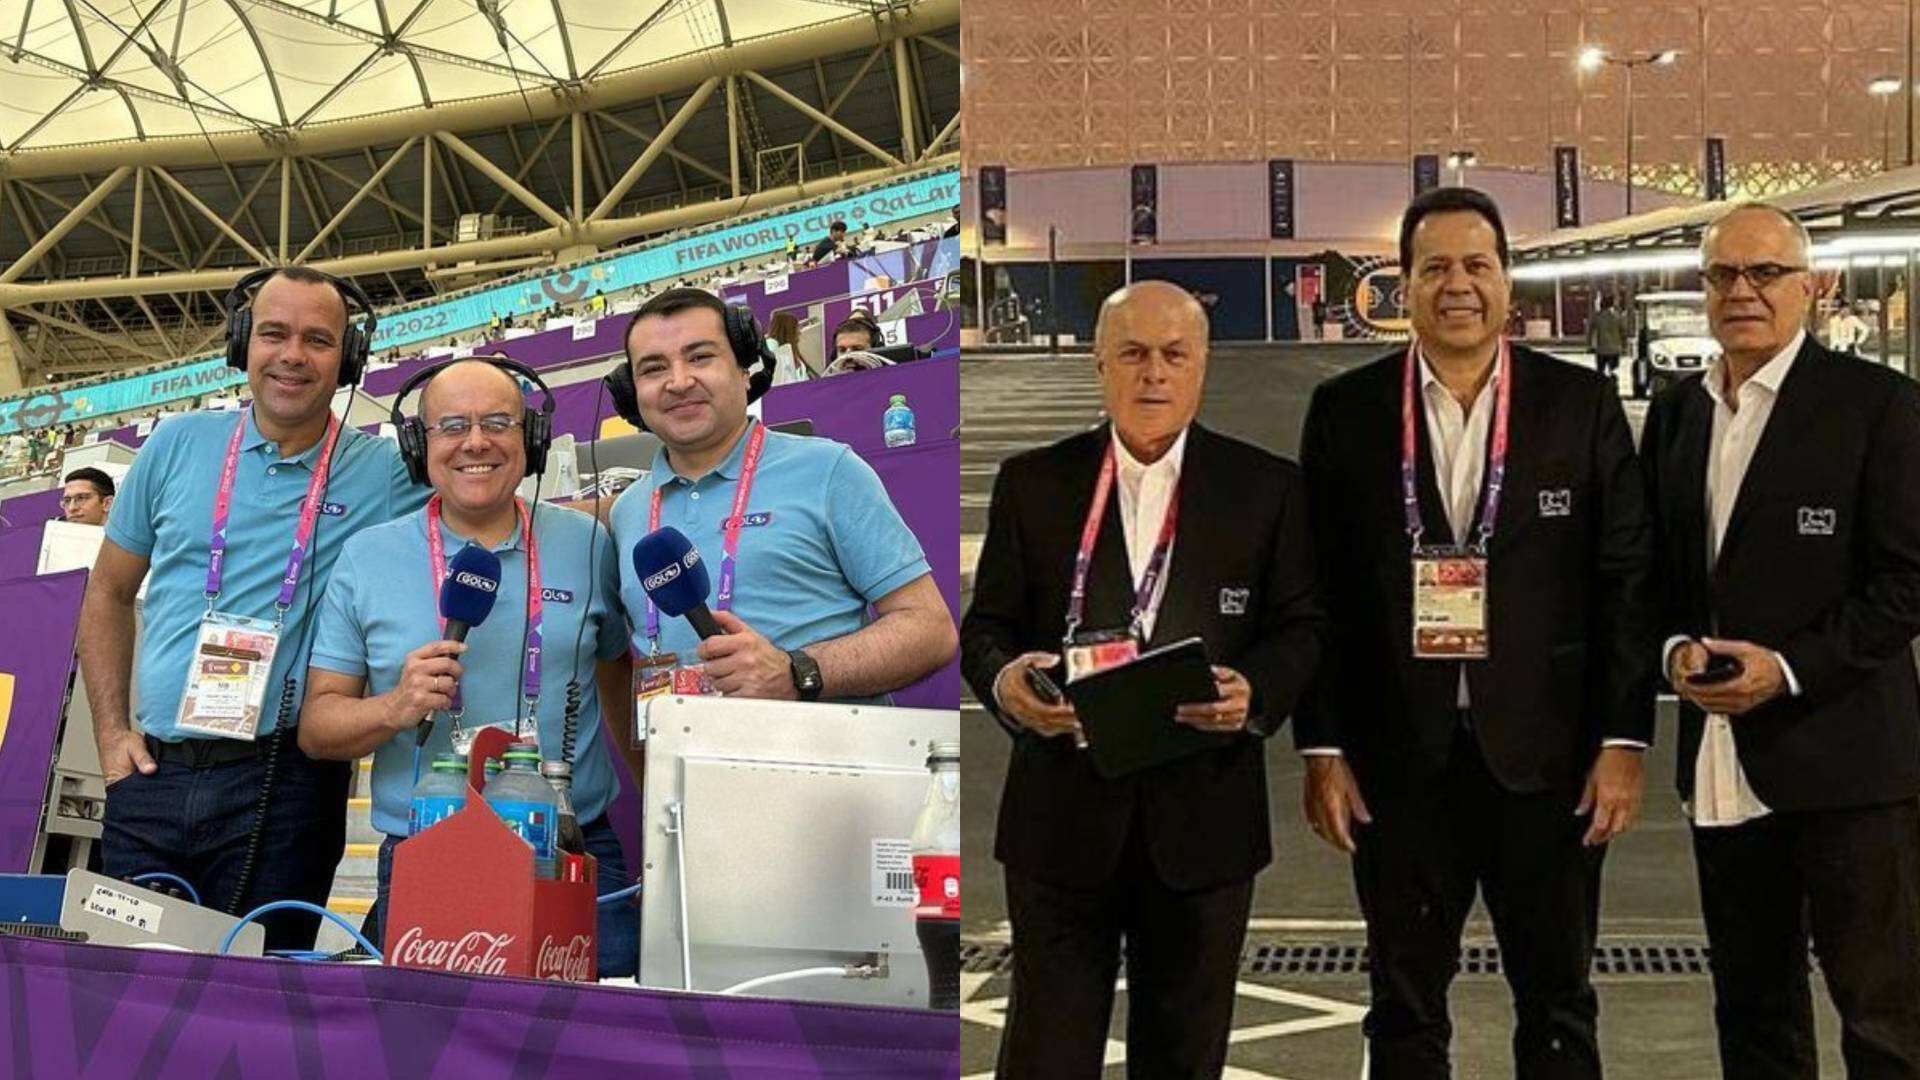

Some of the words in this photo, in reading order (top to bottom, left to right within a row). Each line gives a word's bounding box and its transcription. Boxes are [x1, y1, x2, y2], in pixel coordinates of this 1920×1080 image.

[676, 243, 717, 264] FIFA
[721, 223, 798, 251] WORLD
[804, 210, 845, 232] CUP
[150, 374, 192, 396] FIFA
